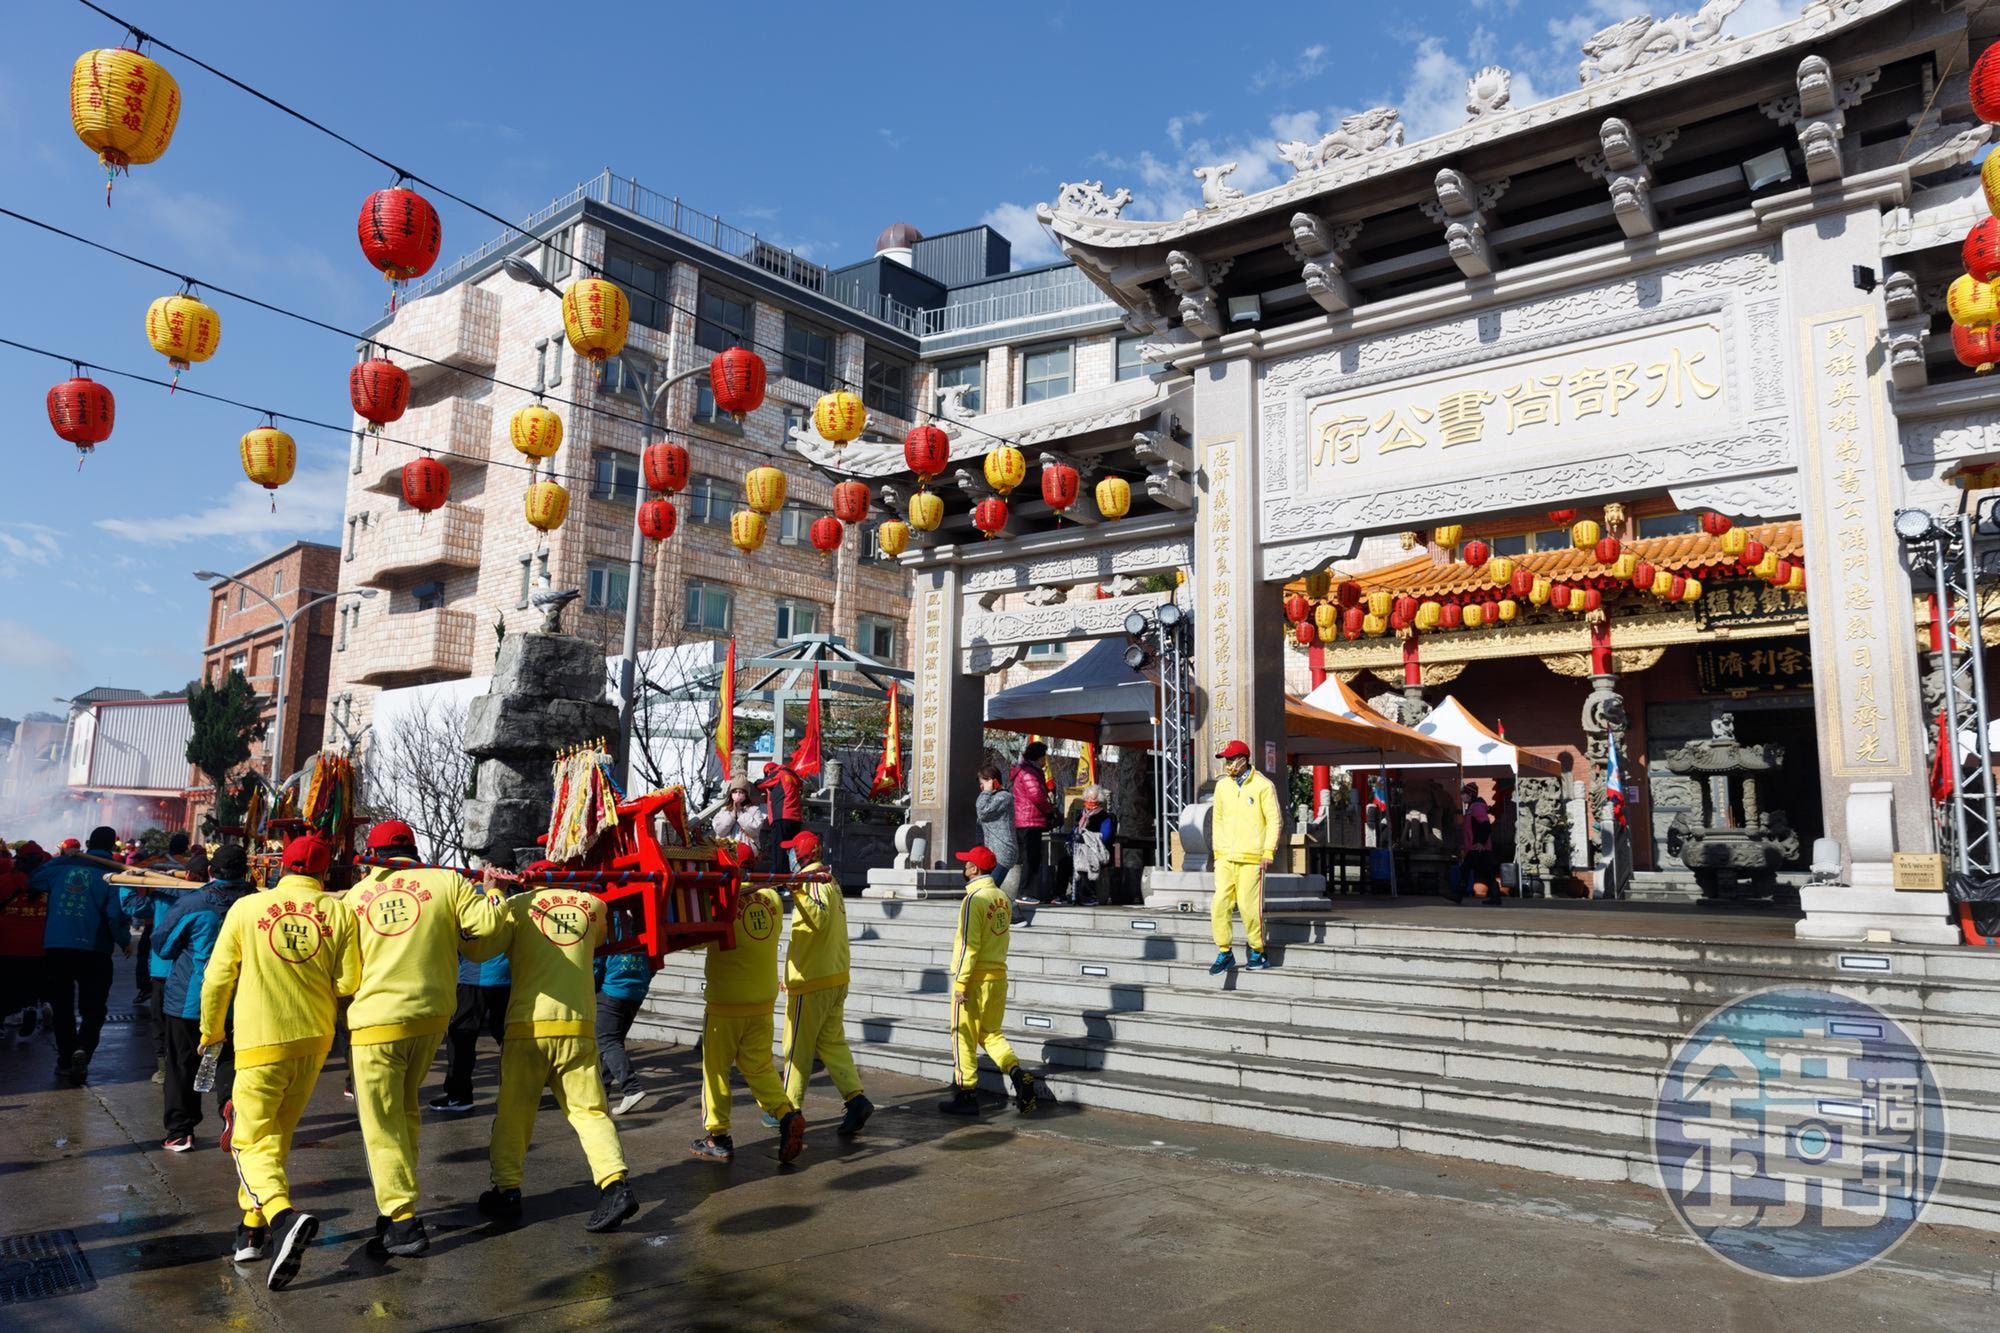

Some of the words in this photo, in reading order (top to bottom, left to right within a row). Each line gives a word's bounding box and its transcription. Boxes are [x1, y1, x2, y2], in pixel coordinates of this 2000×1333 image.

[123, 63, 150, 132] 王母娘娘
[589, 282, 603, 328] 王母娘娘
[828, 401, 837, 431] 齊天大聖
[1313, 346, 1721, 467] 水部尚書公府
[1824, 323, 1889, 764] 民族英雄尚書公滿門忠烈日月齊光
[1718, 646, 1813, 678] 宗利濟
[355, 877, 433, 917] 水部尚書公府
[530, 895, 598, 922] 水部尚書公府
[257, 900, 334, 938] 水部尚書公府
